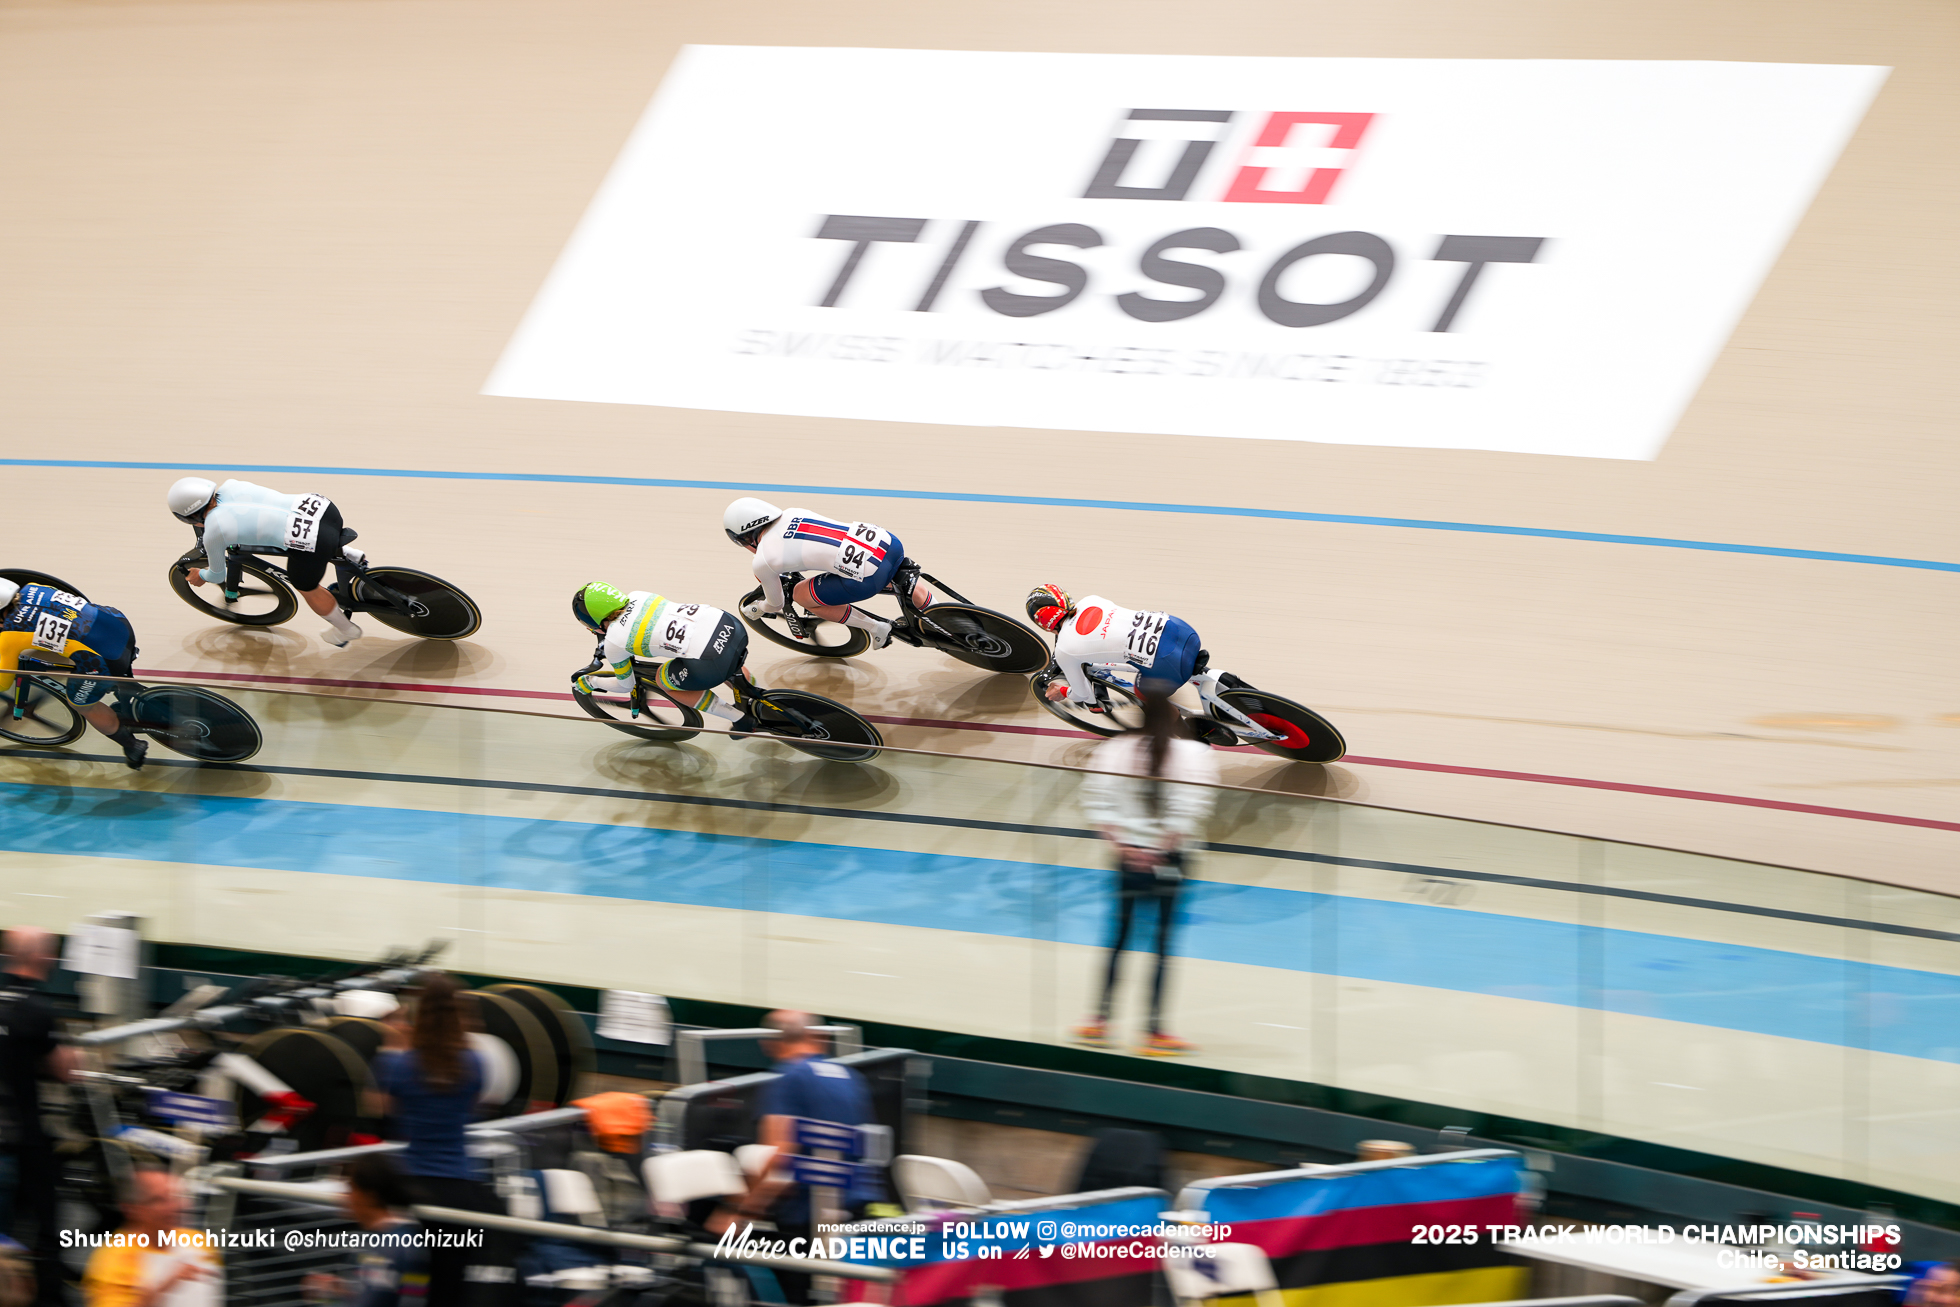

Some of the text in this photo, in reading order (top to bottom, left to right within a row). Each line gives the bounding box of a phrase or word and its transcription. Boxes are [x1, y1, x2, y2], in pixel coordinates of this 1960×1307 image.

[810, 214, 1550, 334] TISSOT
[291, 517, 313, 540] 57
[740, 516, 770, 532] LAZER
[782, 517, 802, 539] GBR
[842, 545, 865, 569] 94
[14, 586, 38, 623] UKRAINE
[38, 617, 69, 643] 137
[666, 620, 687, 644] 64
[785, 612, 803, 636] LOTUS
[1100, 608, 1117, 639] JAPAN
[1127, 629, 1158, 656] 116
